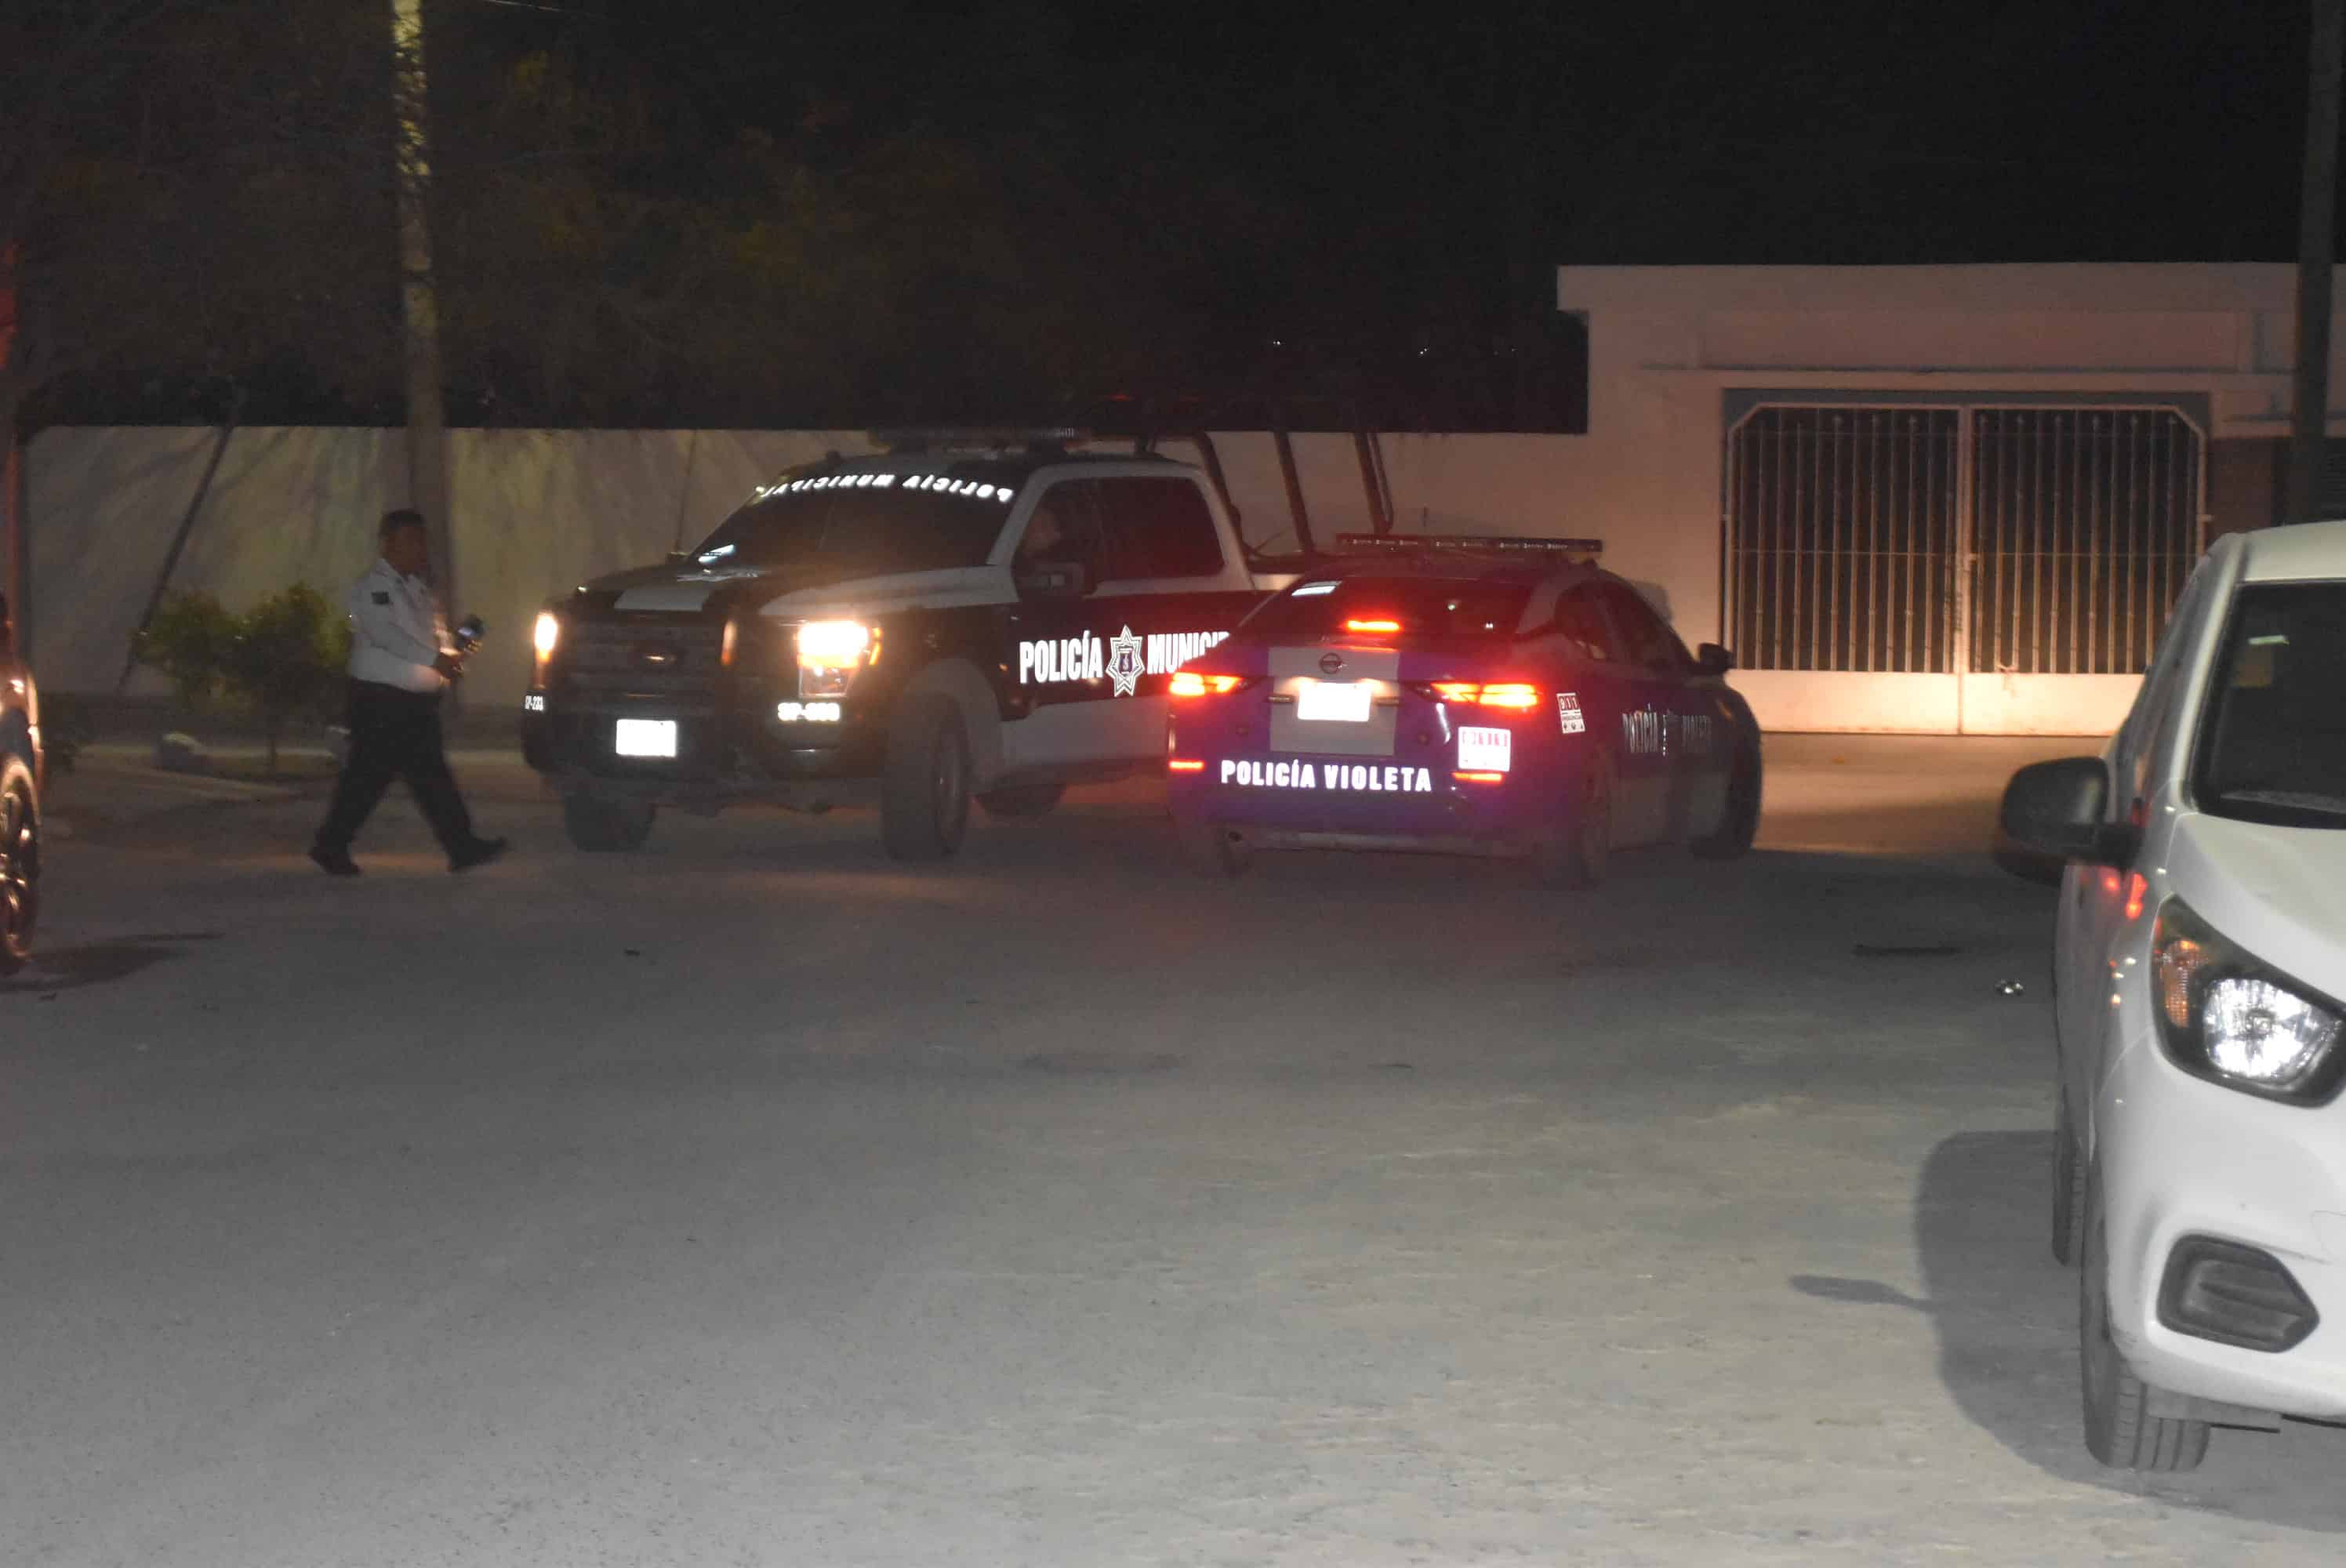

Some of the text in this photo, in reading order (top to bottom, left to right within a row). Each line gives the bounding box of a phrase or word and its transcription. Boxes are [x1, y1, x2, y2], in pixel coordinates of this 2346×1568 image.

[1019, 630, 1104, 684] POLICÍA
[1221, 759, 1432, 792] POLICÍA VIOLETA
